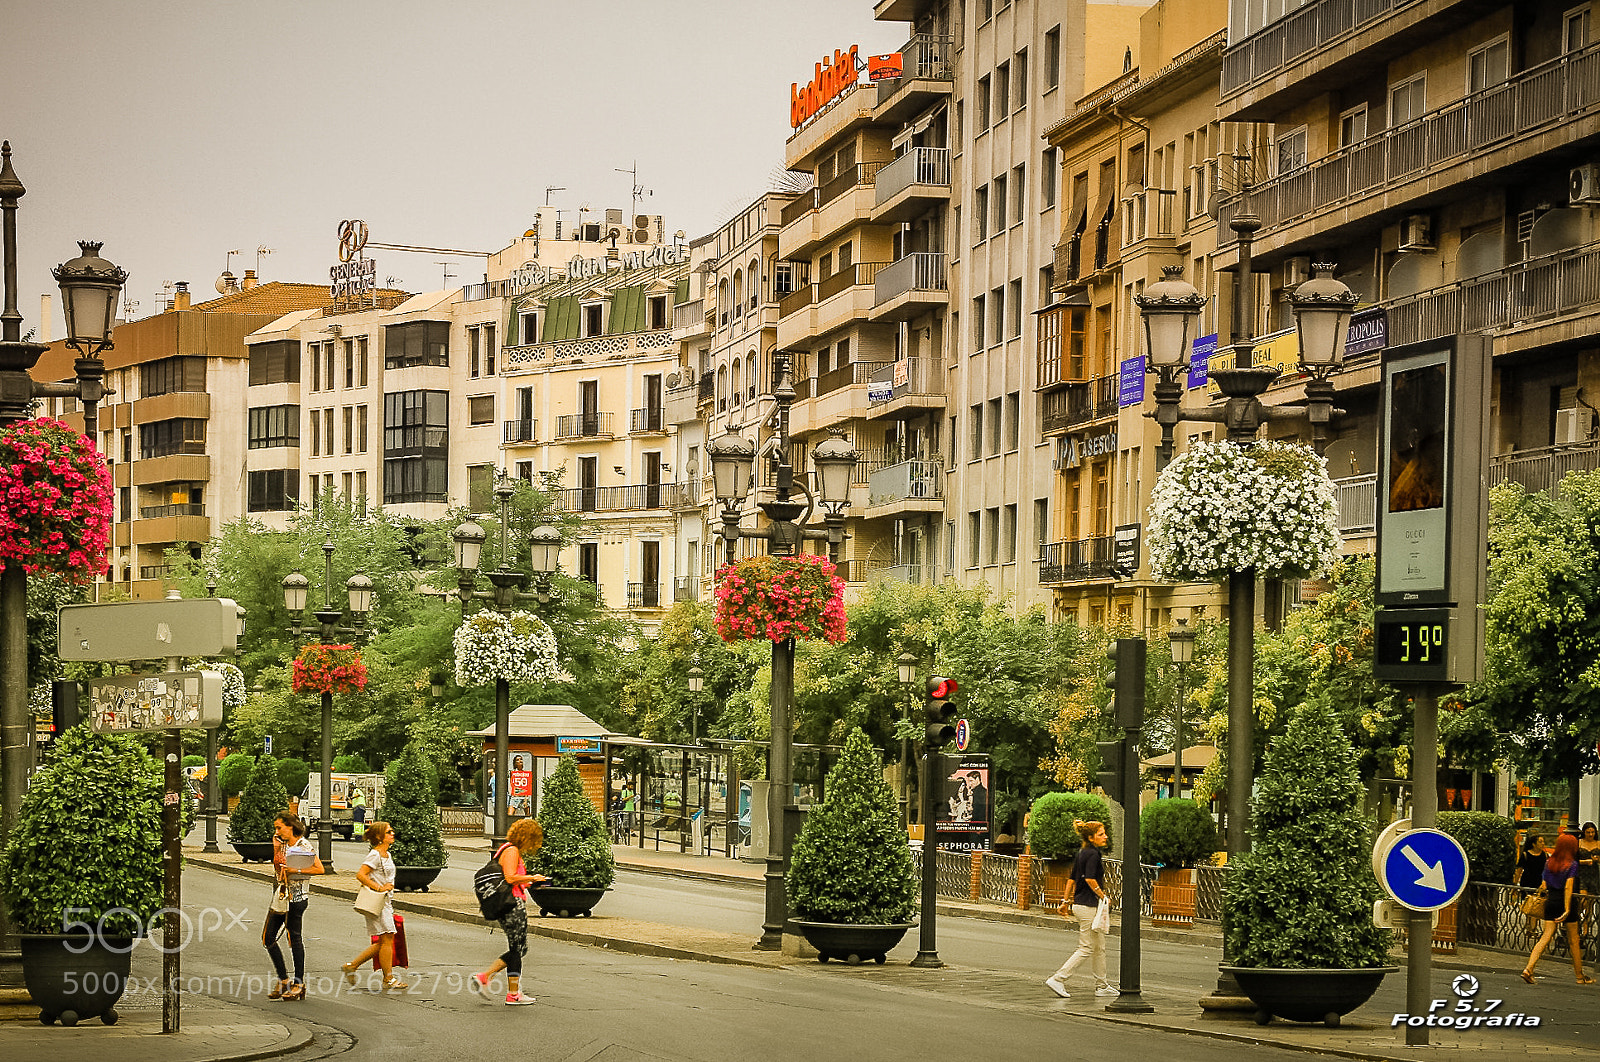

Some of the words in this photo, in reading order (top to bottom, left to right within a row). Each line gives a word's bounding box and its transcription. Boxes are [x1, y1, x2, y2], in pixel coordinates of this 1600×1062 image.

[791, 44, 858, 128] bankinter
[329, 259, 376, 279] GENERAL
[1253, 346, 1272, 367] REAL
[1405, 529, 1426, 539] GUCCI
[938, 842, 983, 850] SEPHORA
